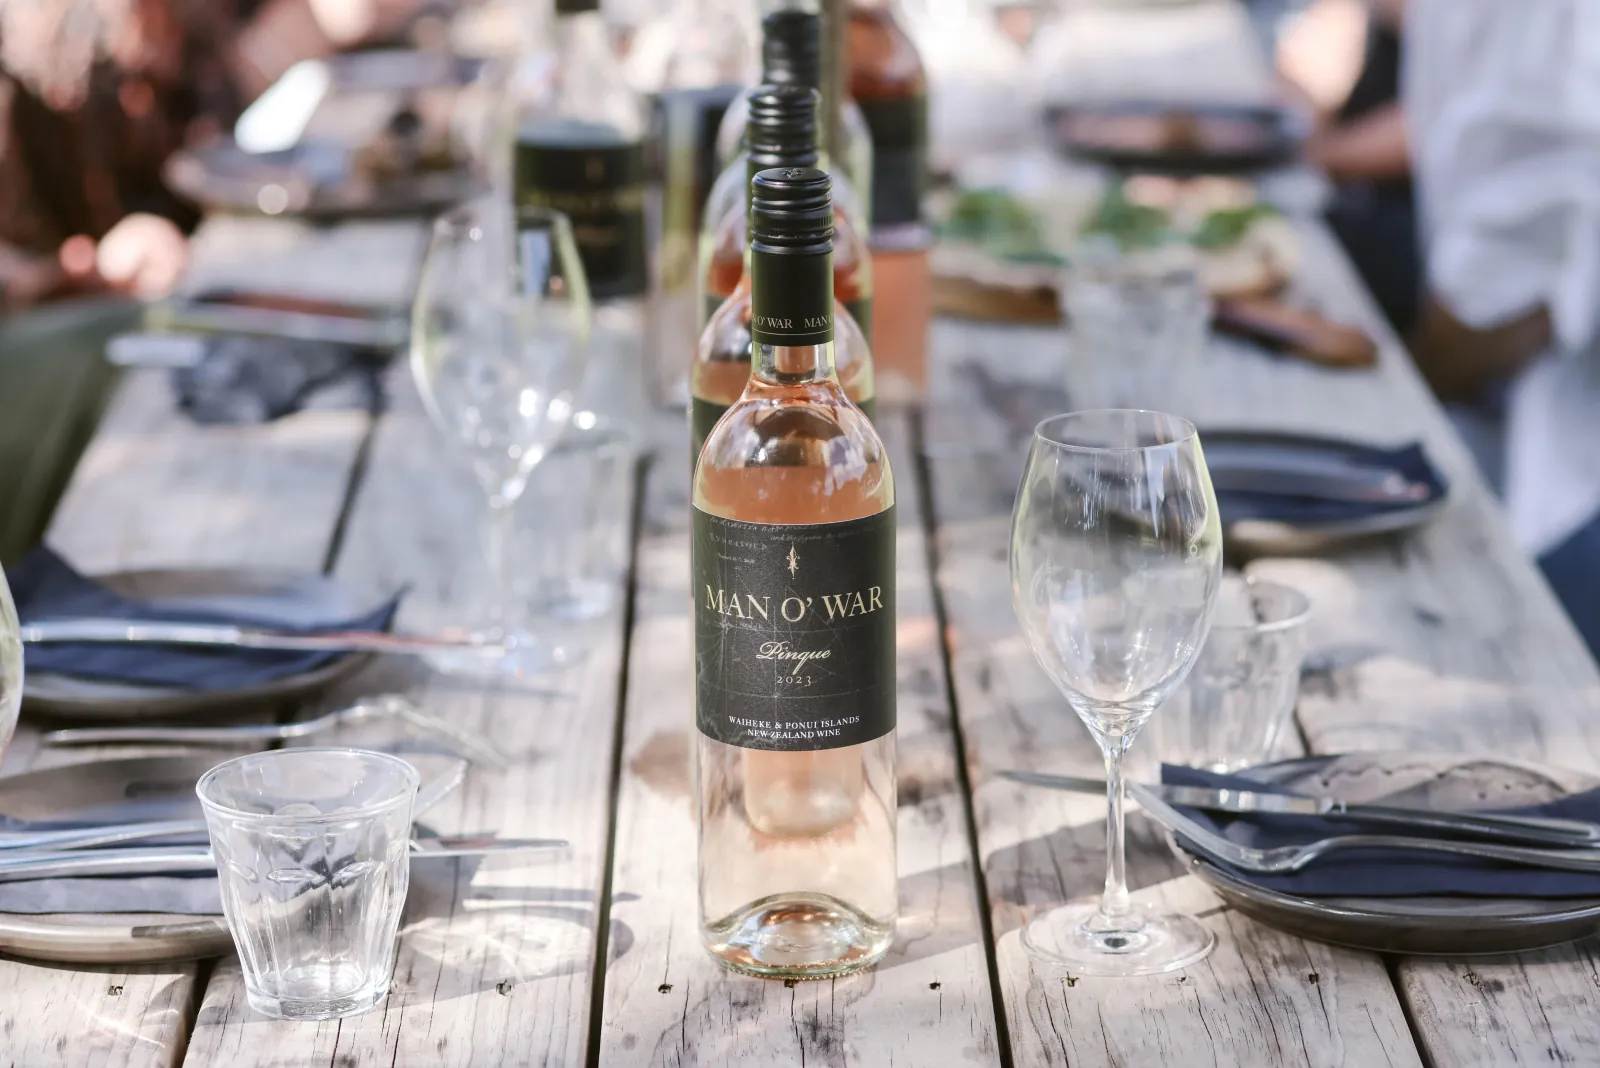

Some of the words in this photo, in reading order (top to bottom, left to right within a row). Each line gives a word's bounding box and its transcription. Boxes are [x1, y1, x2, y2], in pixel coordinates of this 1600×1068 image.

[767, 317, 793, 329] WAR
[804, 314, 828, 329] MAN
[705, 584, 771, 620] MAN
[781, 592, 813, 623] O'
[821, 585, 884, 619] WAR
[755, 641, 832, 675] Pinque
[776, 675, 812, 686] 2023
[728, 715, 772, 729] WAIHEKE
[774, 721, 782, 729] &
[785, 720, 818, 729] PONUI
[820, 716, 860, 728] ISLANDS
[747, 729, 770, 738] NEW
[770, 729, 814, 739] ZEALAND
[816, 728, 841, 737] WINE
